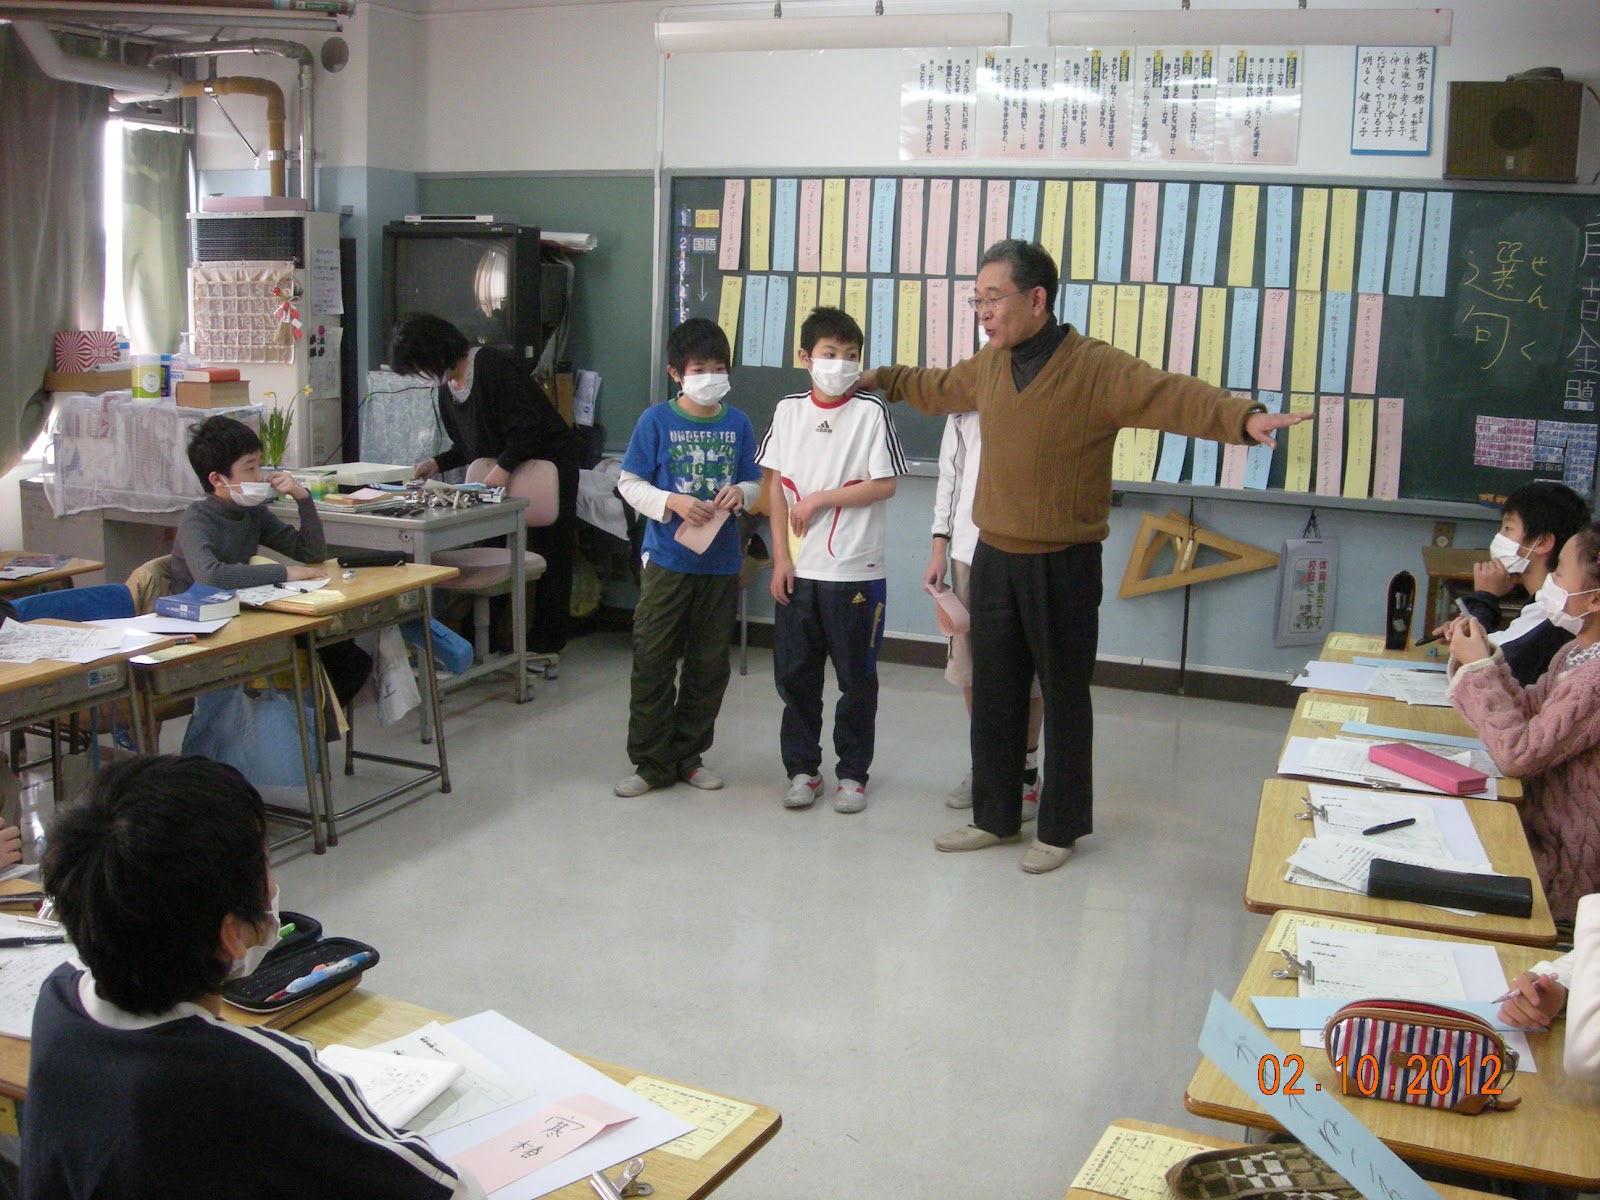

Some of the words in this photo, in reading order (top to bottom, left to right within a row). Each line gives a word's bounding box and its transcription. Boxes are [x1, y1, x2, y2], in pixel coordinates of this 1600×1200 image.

[1411, 51, 1430, 105] 教育目標
[1021, 183, 1032, 191] 14
[1051, 184, 1062, 192] 13
[1079, 184, 1091, 192] 12
[693, 238, 716, 251] 国語
[1153, 288, 1163, 296] 33
[1182, 291, 1193, 299] 32
[1208, 289, 1219, 298] 31
[1241, 291, 1252, 300] 30
[1272, 292, 1284, 300] 29
[1303, 294, 1314, 302] 28
[1333, 293, 1345, 301] 27
[1366, 294, 1376, 302] 26
[1462, 241, 1524, 370] 選句
[1297, 396, 1309, 405] 53
[1357, 400, 1368, 409] 51
[1386, 402, 1398, 410] 50
